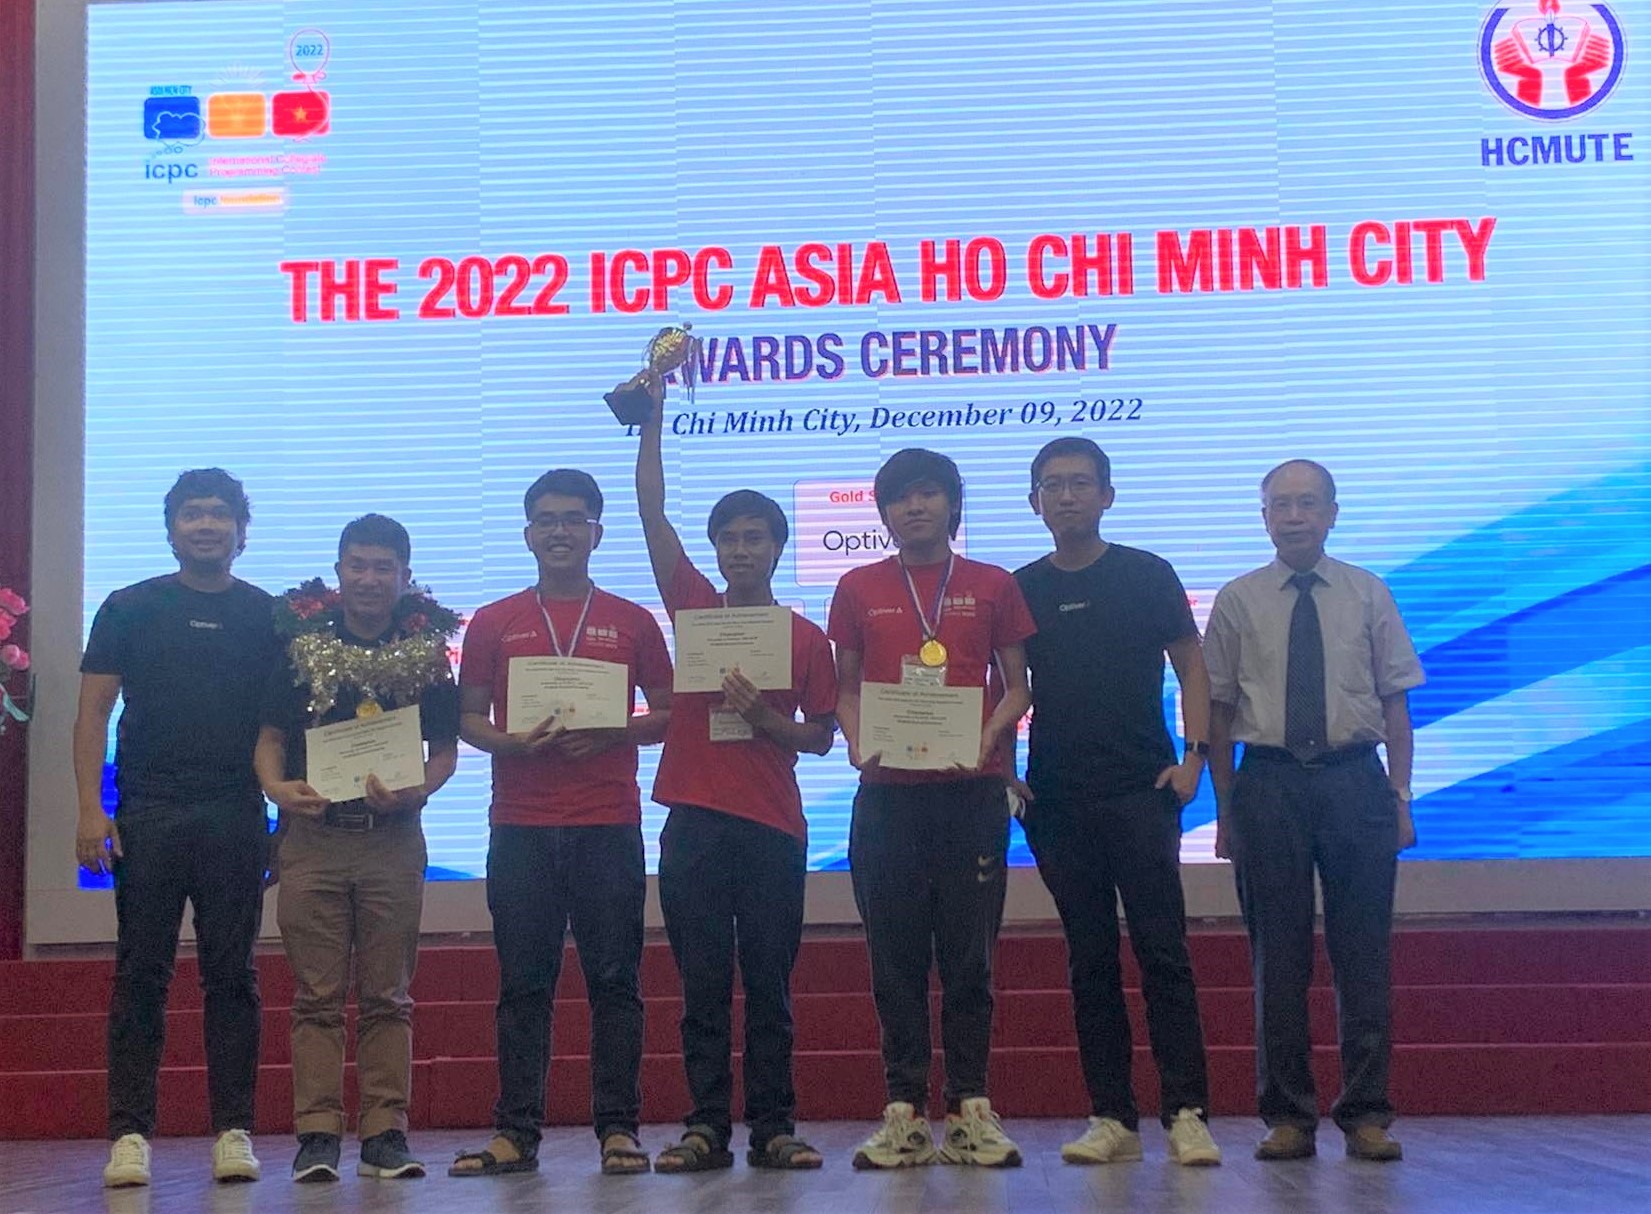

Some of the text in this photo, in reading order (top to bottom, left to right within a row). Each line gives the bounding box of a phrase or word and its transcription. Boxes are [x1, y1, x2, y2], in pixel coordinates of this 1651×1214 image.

[296, 44, 324, 57] 2022
[1481, 132, 1634, 166] HCMUTE
[145, 159, 199, 184] icpc
[280, 216, 1496, 322] THE 2022 ICPC ASIA HO CHI MINH CITY
[664, 324, 1118, 385] WARDS CEREMONY
[672, 398, 1143, 436] Chi Minh City, December 09, 2022
[829, 490, 864, 504] Gold
[823, 529, 892, 556] Optiv
